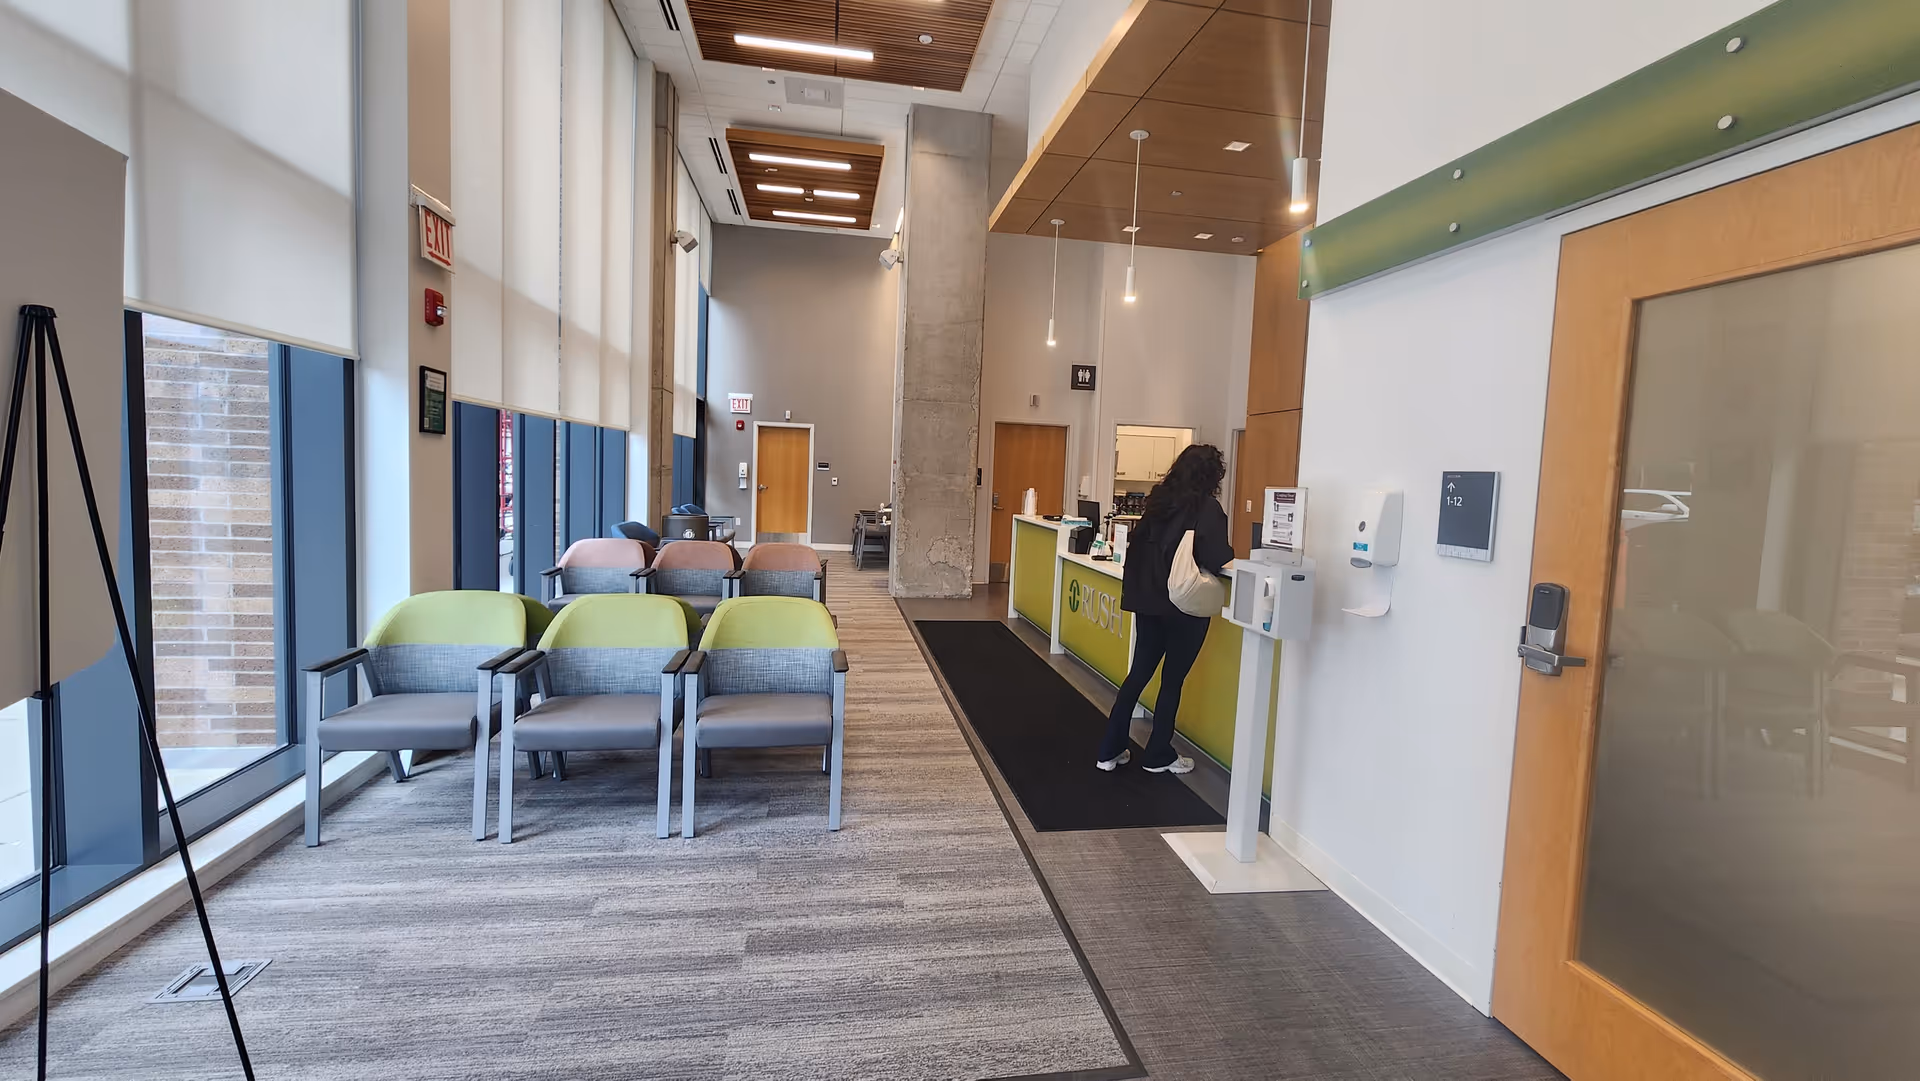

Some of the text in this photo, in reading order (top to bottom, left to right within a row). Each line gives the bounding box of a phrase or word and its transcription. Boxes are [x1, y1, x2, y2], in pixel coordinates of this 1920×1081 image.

[424, 208, 451, 260] EXIT
[732, 398, 749, 410] EXIT
[1446, 495, 1463, 507] 1-12
[1082, 583, 1123, 639] RUSH
